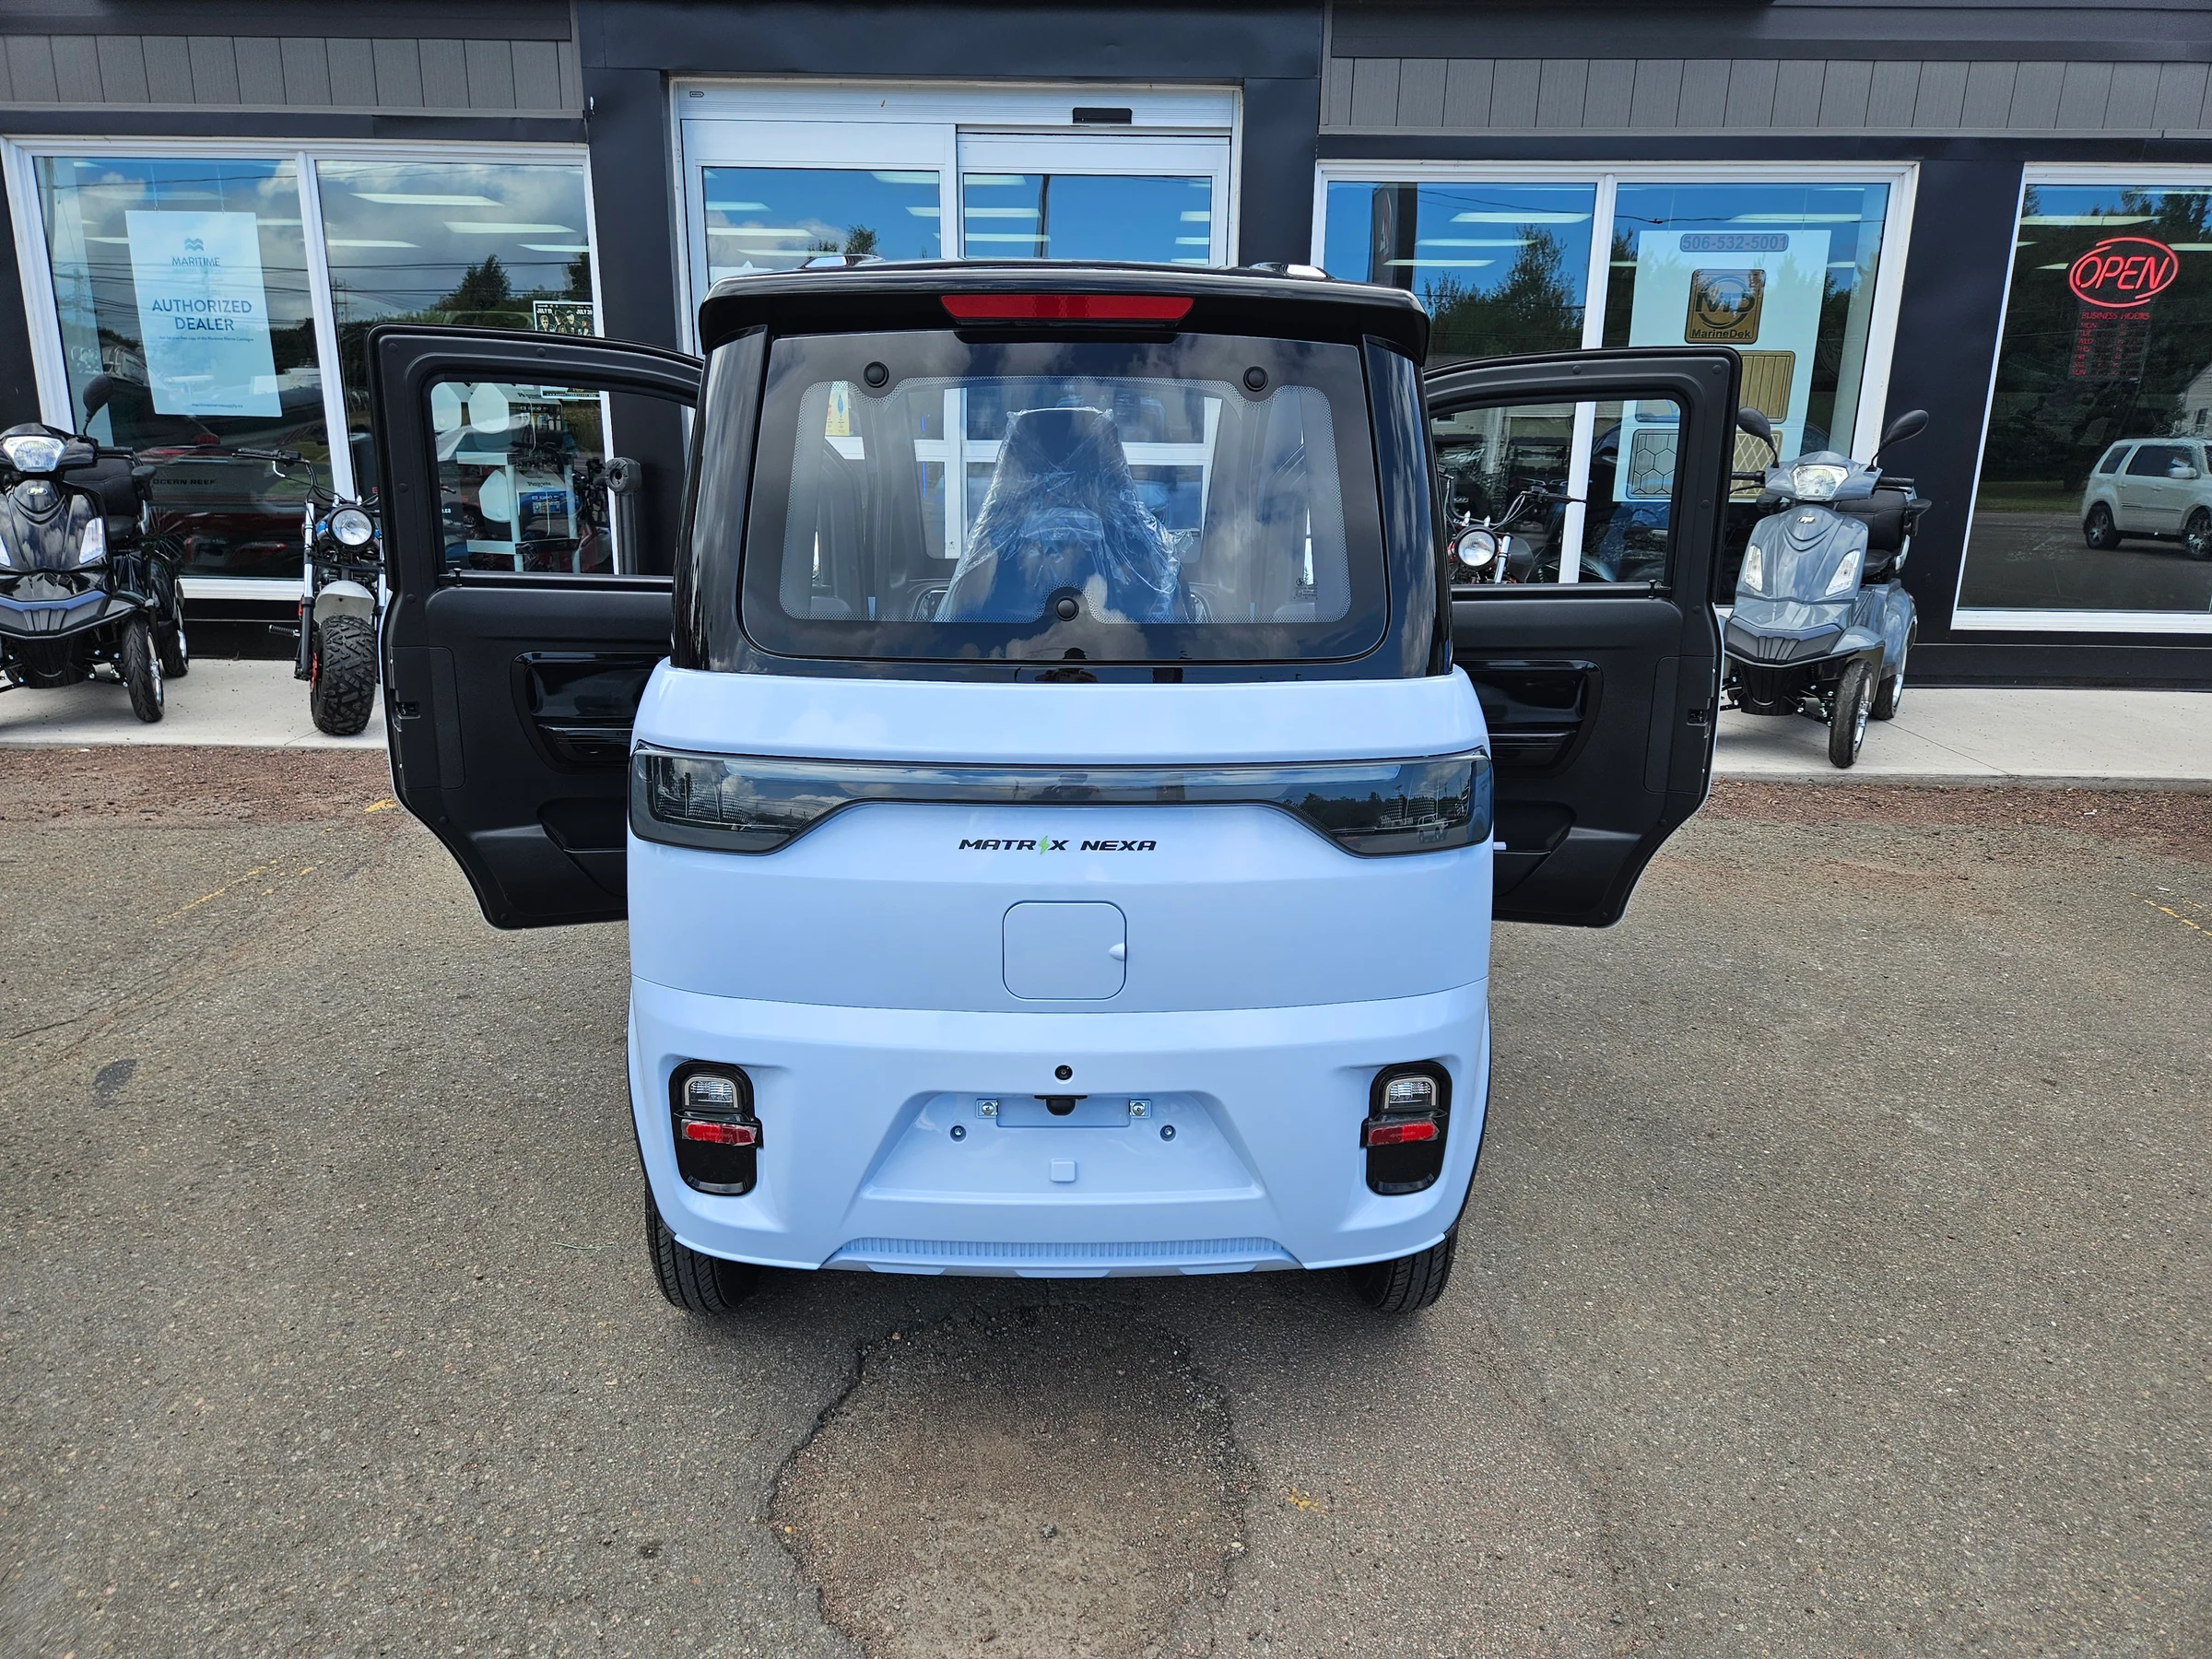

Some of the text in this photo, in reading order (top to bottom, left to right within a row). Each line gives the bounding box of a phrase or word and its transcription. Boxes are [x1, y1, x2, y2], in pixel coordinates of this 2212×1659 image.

[1682, 235, 1787, 250] 506-532-5001
[171, 257, 221, 267] MARITIME
[2075, 256, 2171, 289] OPEN
[152, 299, 253, 313] AUTHORIZED
[2081, 312, 2118, 320] BUSINESS
[174, 317, 235, 331] DEALER
[1691, 328, 1751, 339] MarineDek
[959, 836, 1158, 854] MATRIX NEXA
